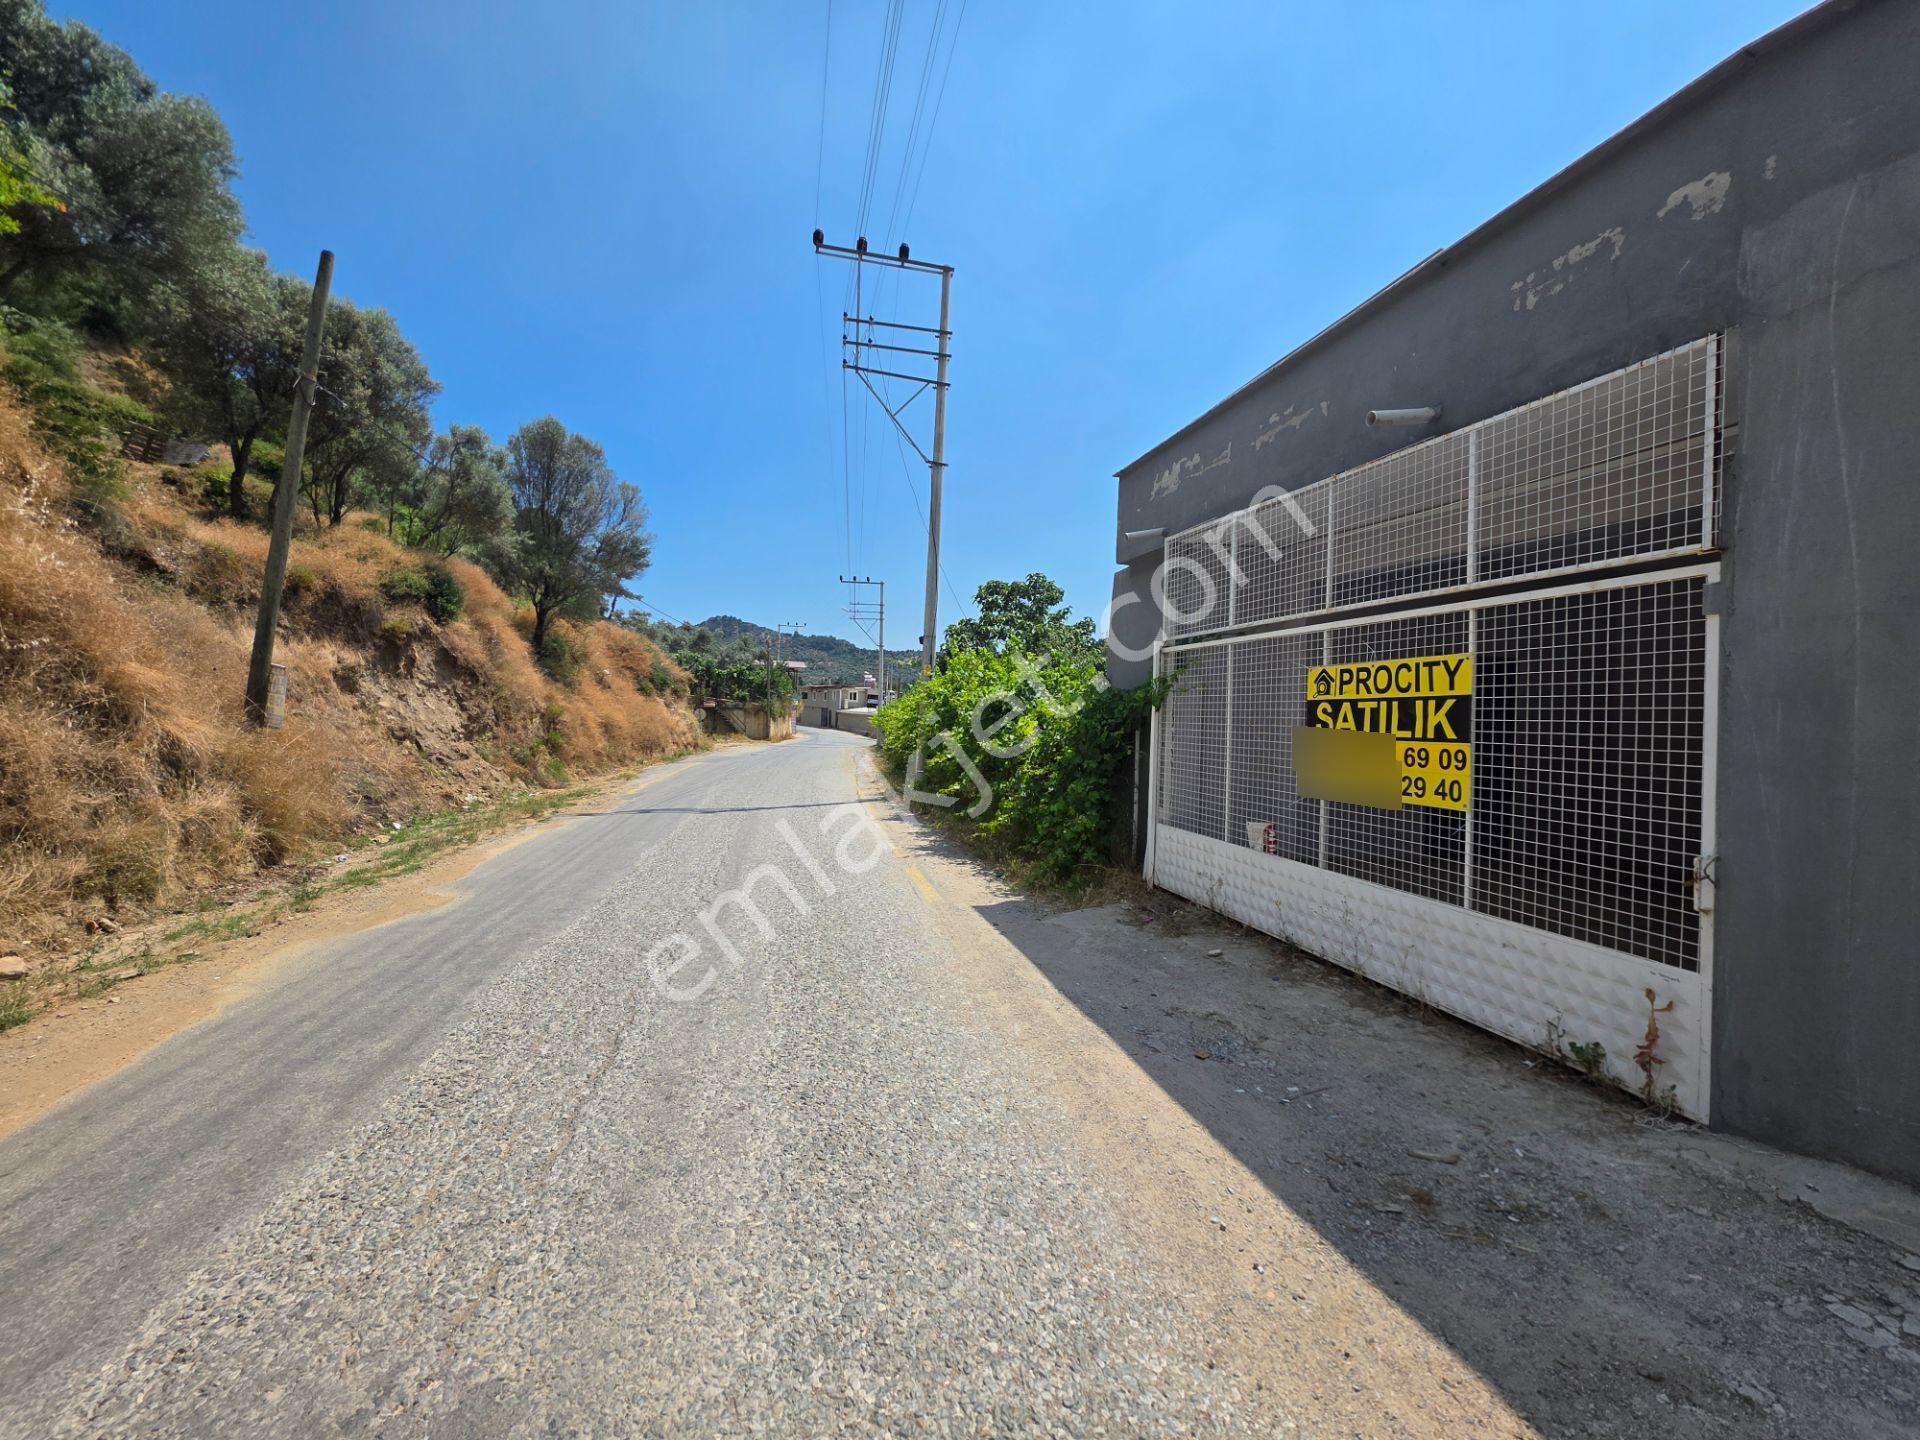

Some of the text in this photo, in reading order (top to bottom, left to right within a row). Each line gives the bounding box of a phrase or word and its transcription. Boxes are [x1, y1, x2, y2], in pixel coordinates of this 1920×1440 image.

[1338, 658, 1465, 696] PROCITY
[1315, 698, 1458, 740] SATILIK
[1403, 747, 1467, 771] 69 09
[1401, 775, 1462, 803] 29 40
